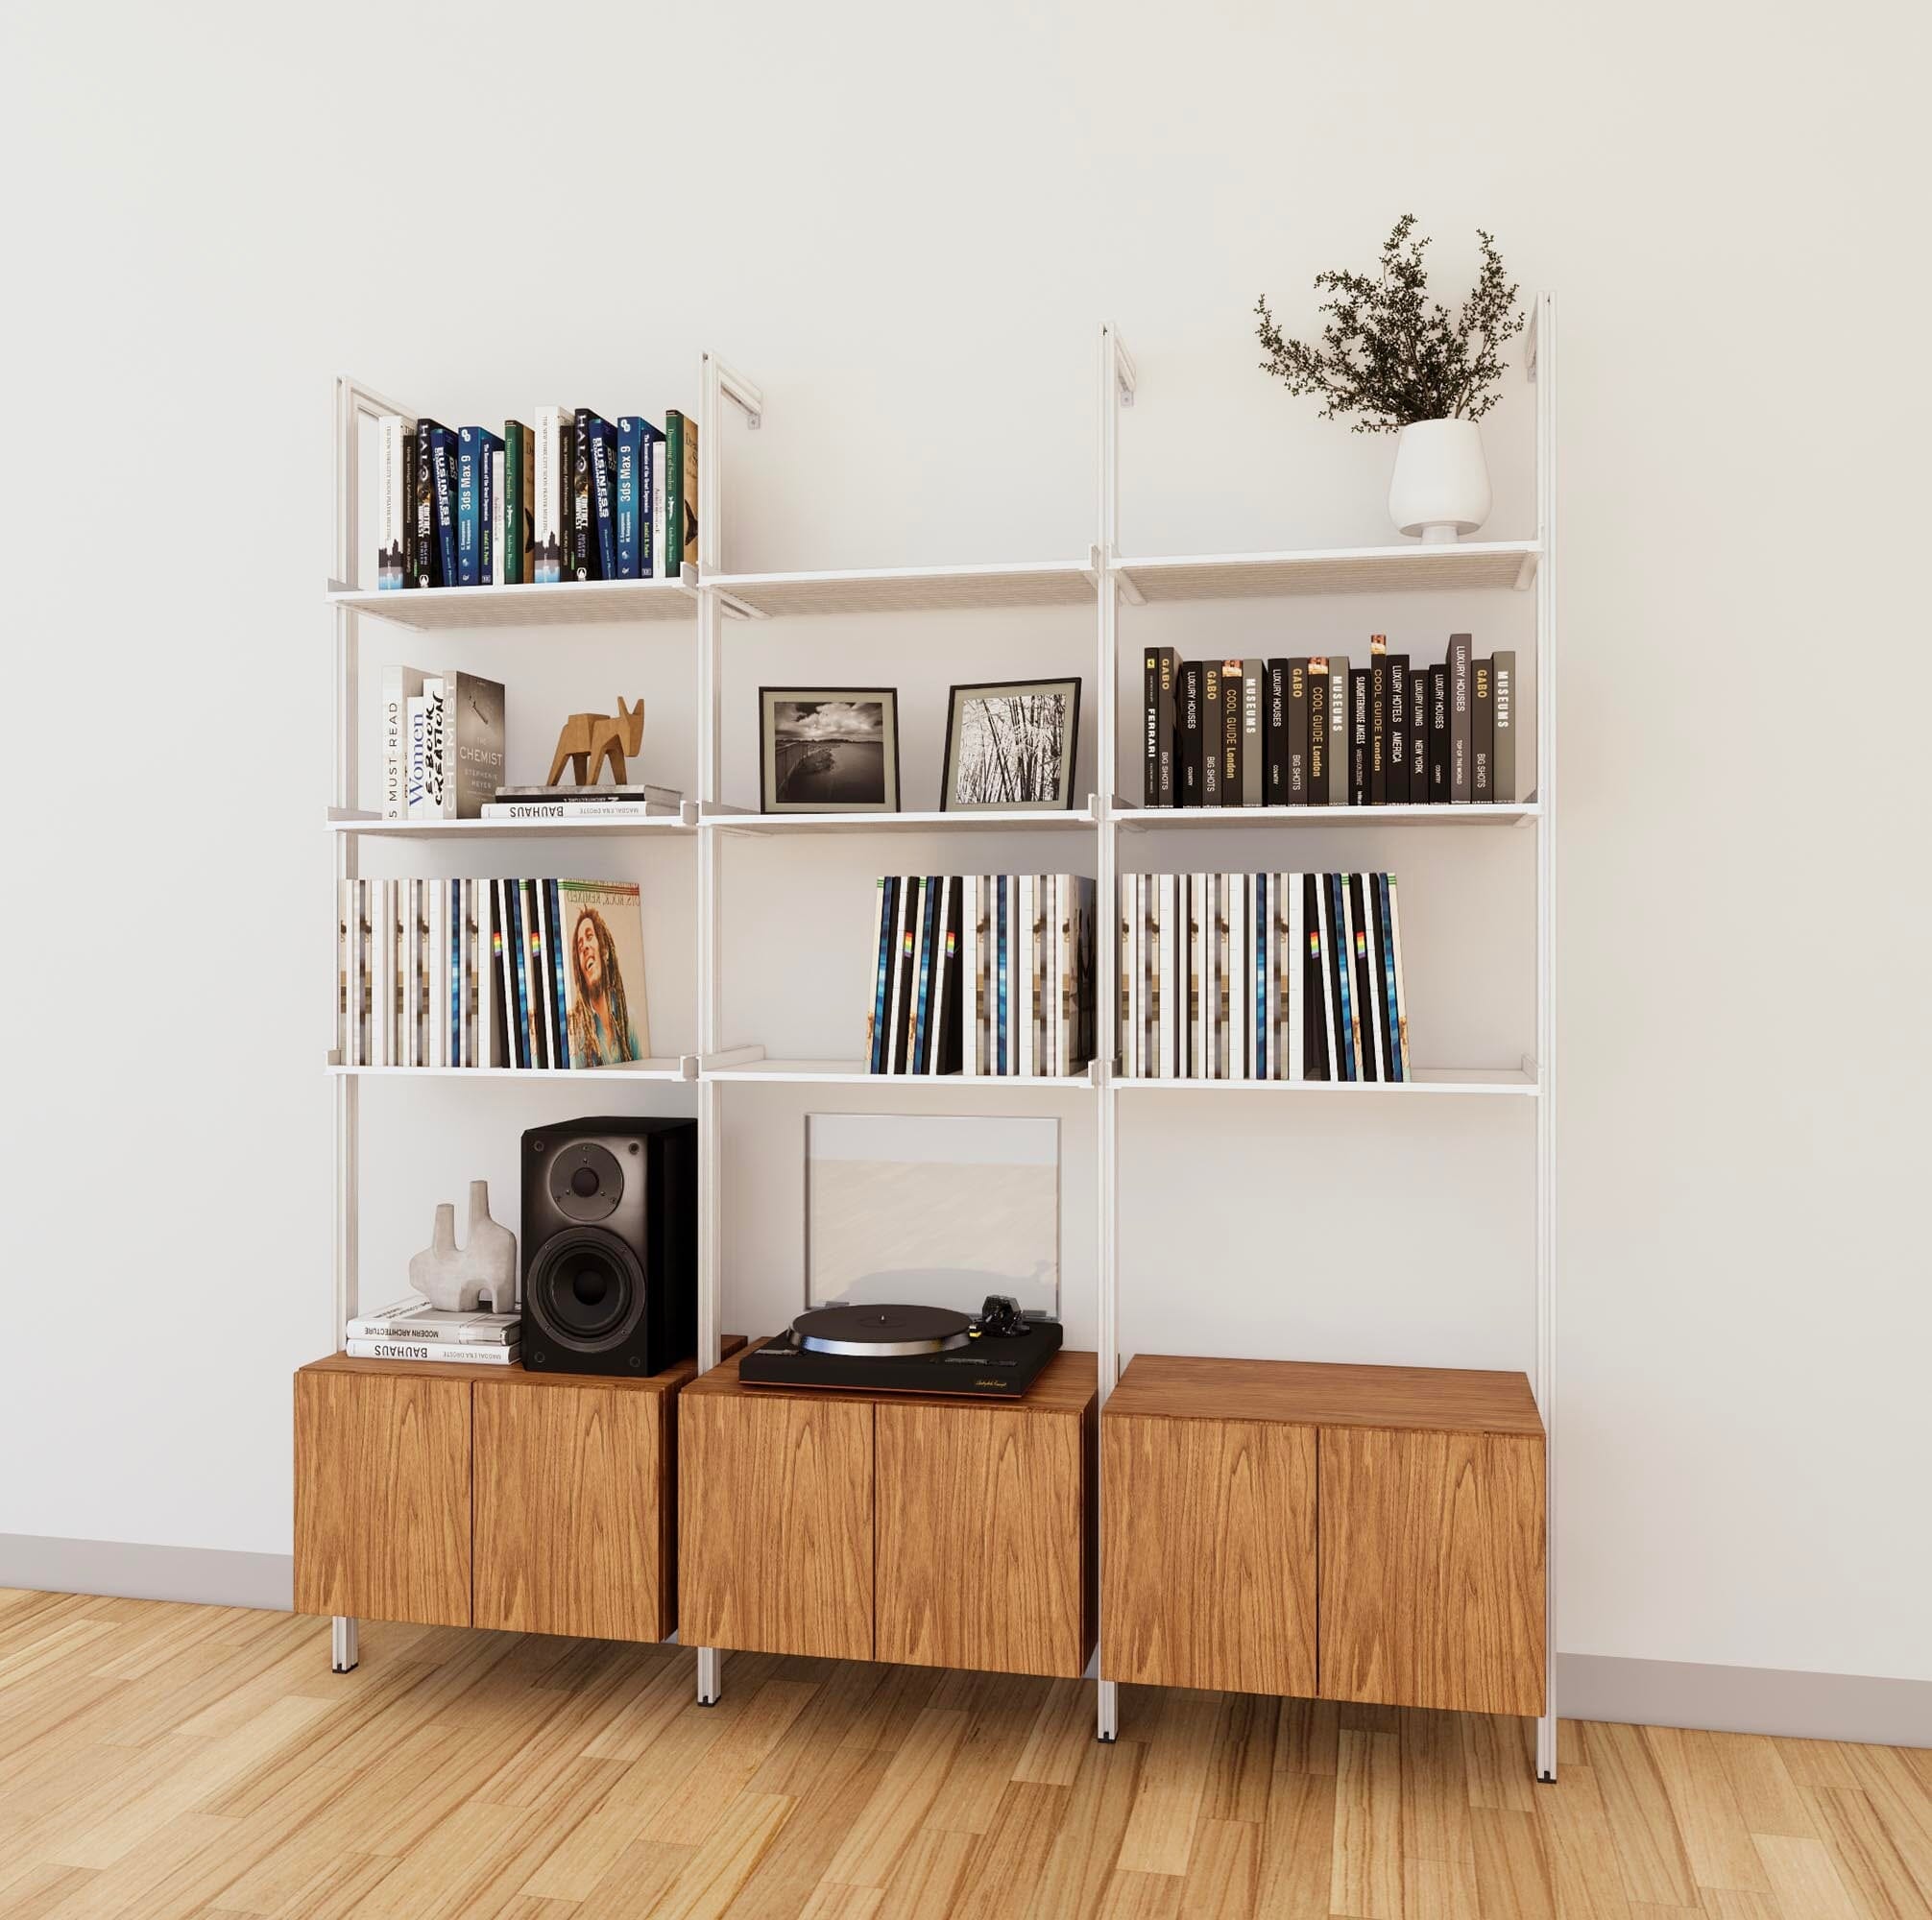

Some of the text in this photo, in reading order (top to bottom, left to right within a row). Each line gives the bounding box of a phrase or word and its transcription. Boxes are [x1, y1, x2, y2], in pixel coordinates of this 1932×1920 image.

[419, 424, 428, 482] HALO
[577, 415, 587, 472] HALO
[620, 456, 630, 478] Max
[436, 446, 449, 526] BUSINESS
[461, 466, 471, 488] Max
[461, 492, 471, 511] 3ds
[595, 437, 609, 517] BUSINESS
[620, 483, 631, 501] 3ds
[1207, 671, 1217, 700] GABO
[1435, 674, 1444, 700] LUXURY
[1456, 646, 1465, 677] LUXURY
[1246, 679, 1256, 734] MUSEUMS
[1333, 676, 1342, 732] MUSEUMS
[1392, 665, 1401, 763] LUXURY HOTELS AMERICA
[1435, 702, 1444, 729] HOUSES
[1456, 679, 1465, 711] HOUSES
[1497, 671, 1509, 728] MUSEUMS
[425, 702, 434, 794] E-BOOK
[432, 691, 444, 805] CREATION
[446, 679, 454, 811] CHEMIST
[1226, 689, 1237, 779] COOL GUIDE London
[1292, 668, 1302, 790] GABO BIG SHOTS
[1313, 687, 1323, 777] COOL GUIDE London
[1356, 724, 1365, 744] ANGELS
[1414, 680, 1423, 774] LUXURY LIVING NEW YORK
[1477, 669, 1486, 788] GABO BIG SHOTS
[409, 713, 423, 806] Women
[459, 746, 503, 767] CHEMIST
[510, 805, 564, 817] BAUHAUS
[364, 1328, 439, 1338] MODERN ARCHITECTURE
[374, 1345, 427, 1358] BAUHAUS
